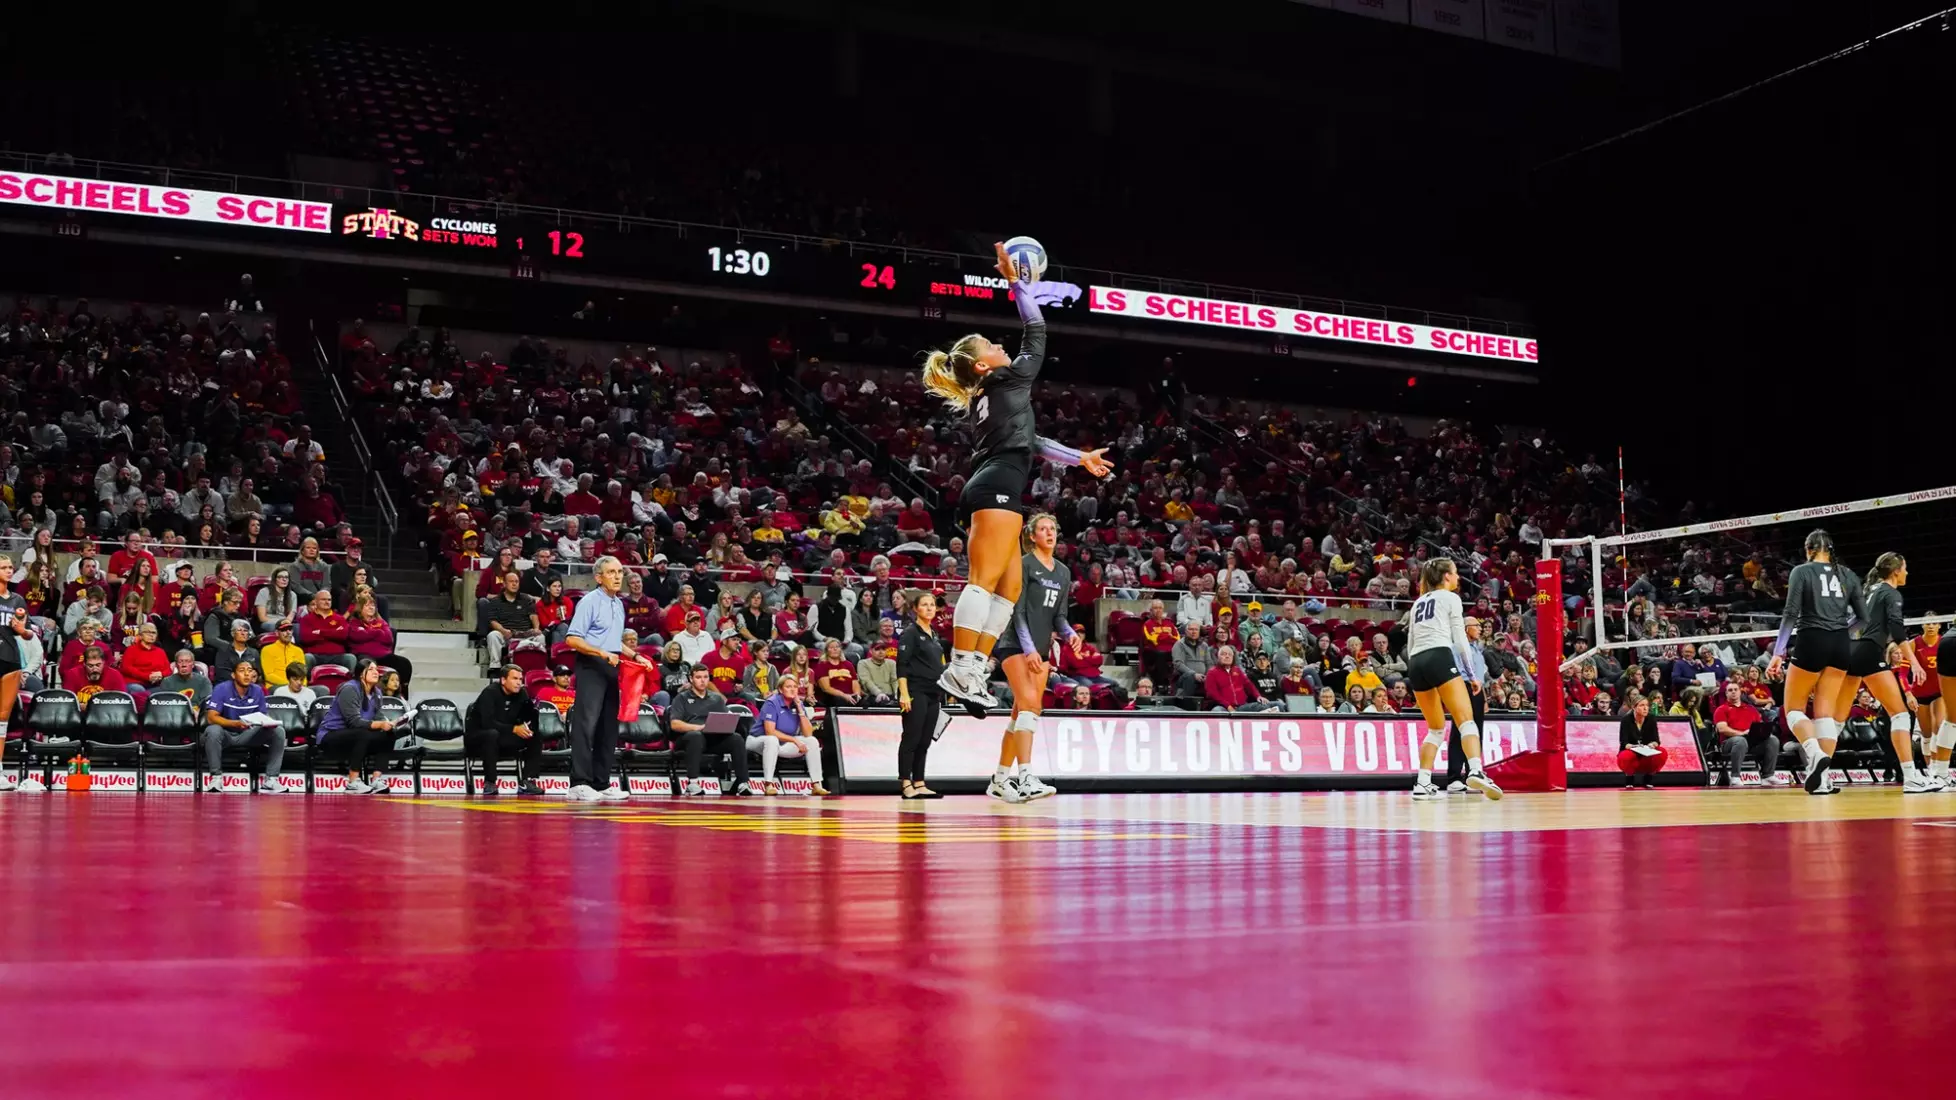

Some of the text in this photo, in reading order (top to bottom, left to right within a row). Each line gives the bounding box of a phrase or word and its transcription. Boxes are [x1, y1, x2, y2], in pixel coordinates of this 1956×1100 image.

[0, 174, 327, 230] SCHEELS SCHE
[57, 223, 81, 237] 110
[342, 207, 419, 241] STATE
[431, 217, 497, 234] CYCLONES
[422, 229, 524, 250] SETS WON 1
[548, 230, 584, 257] 12
[708, 247, 770, 276] 1:30
[860, 263, 896, 290] 24
[931, 282, 961, 296] SETS
[964, 286, 993, 299] WON
[1089, 287, 1538, 360] LS SCHEELS SCHEELS SCHEELS
[976, 395, 990, 426] 3
[1907, 491, 1930, 502] IOWA
[1803, 504, 1850, 518] IOWA STATE
[1709, 518, 1751, 531] IOWA STATE
[1820, 573, 1843, 598] 14
[1043, 588, 1059, 608] 15
[1415, 598, 1436, 624] 20
[1056, 720, 1303, 771] CYCLONES
[147, 775, 192, 788] HyVee
[203, 775, 248, 787] HVee
[422, 778, 464, 791] HyVee
[475, 778, 517, 789] HVee
[630, 779, 670, 792] HyVee
[681, 779, 719, 790] HVee
